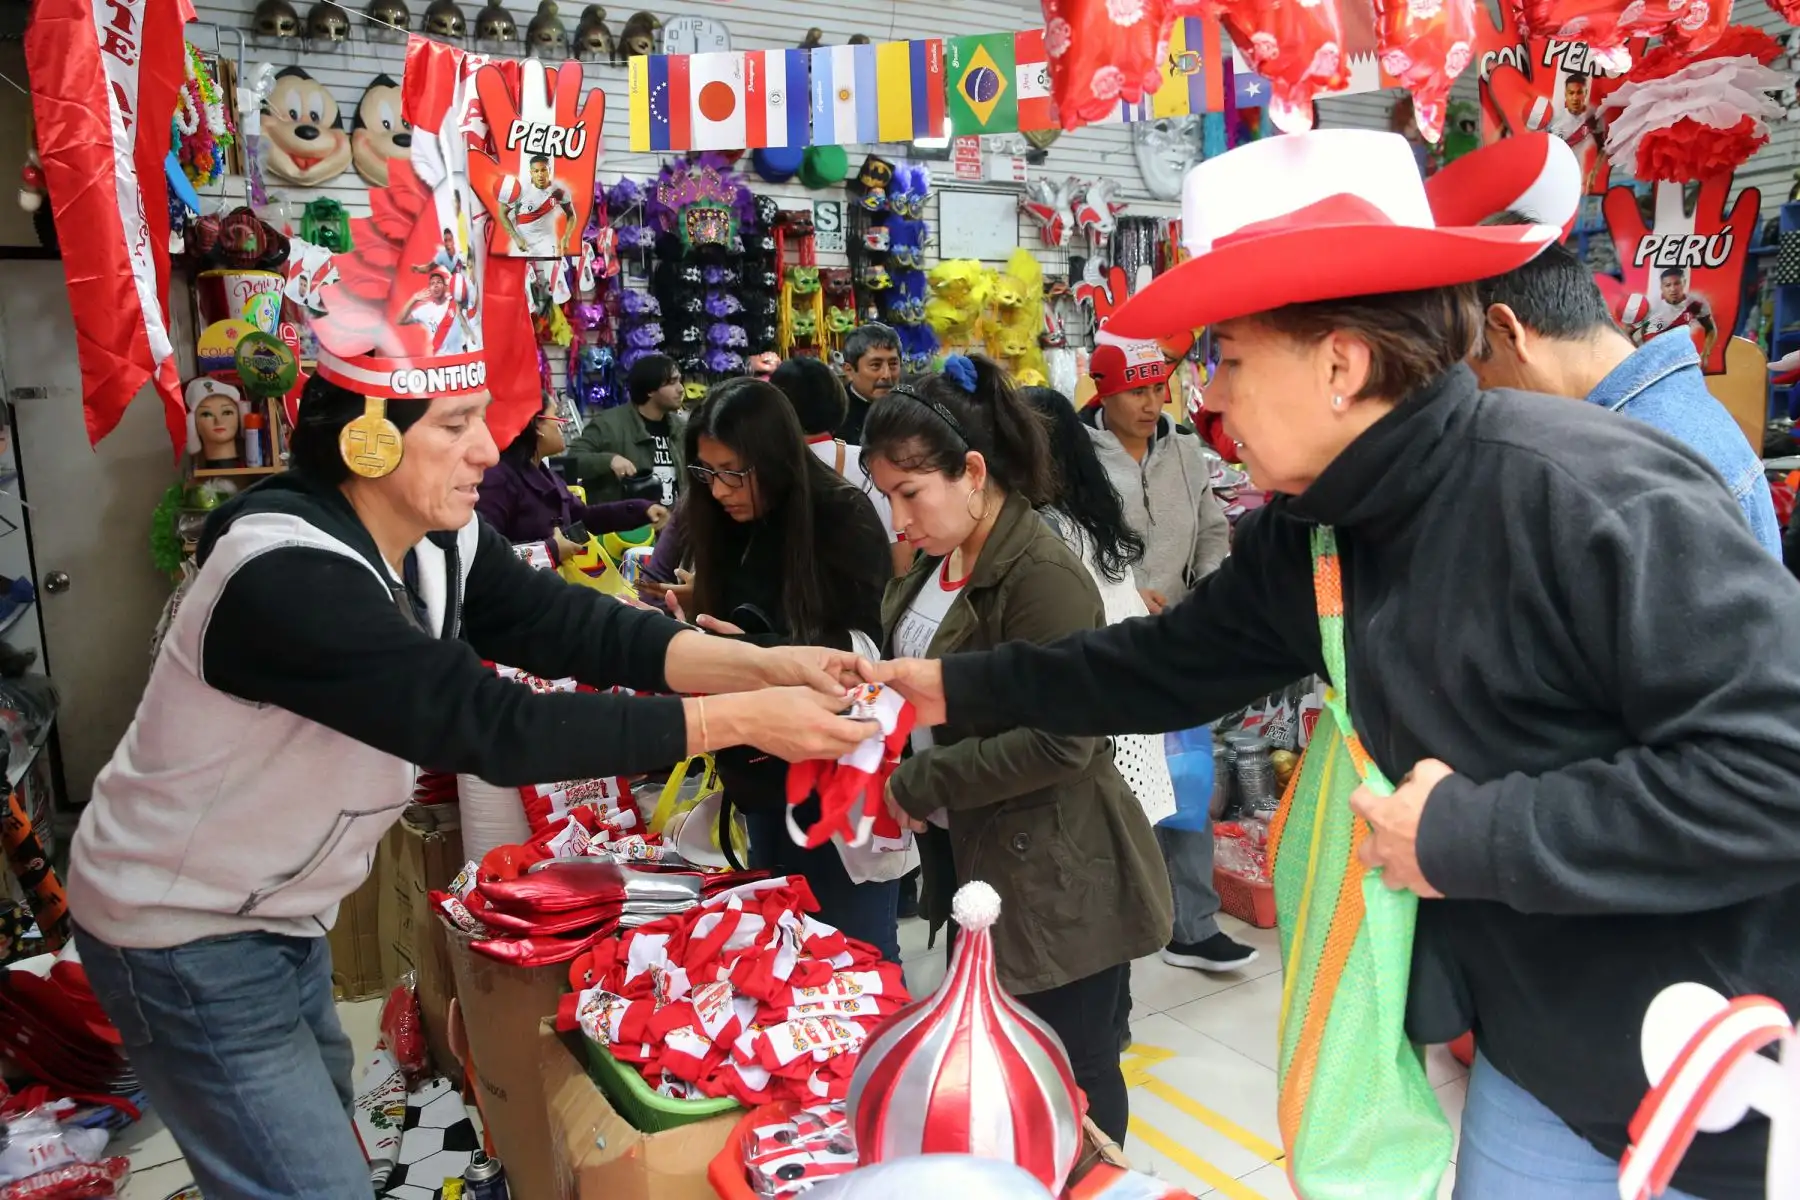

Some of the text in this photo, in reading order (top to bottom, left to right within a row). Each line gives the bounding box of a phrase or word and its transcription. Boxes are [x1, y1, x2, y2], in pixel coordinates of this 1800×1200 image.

[668, 30, 679, 40] 10
[691, 19, 703, 31] 12
[715, 35, 724, 46] 2
[507, 119, 588, 160] PERÚ
[816, 202, 840, 231] S
[1633, 225, 1735, 268] PERÚ
[390, 360, 487, 396] CONTIGO
[1125, 362, 1167, 382] PER
